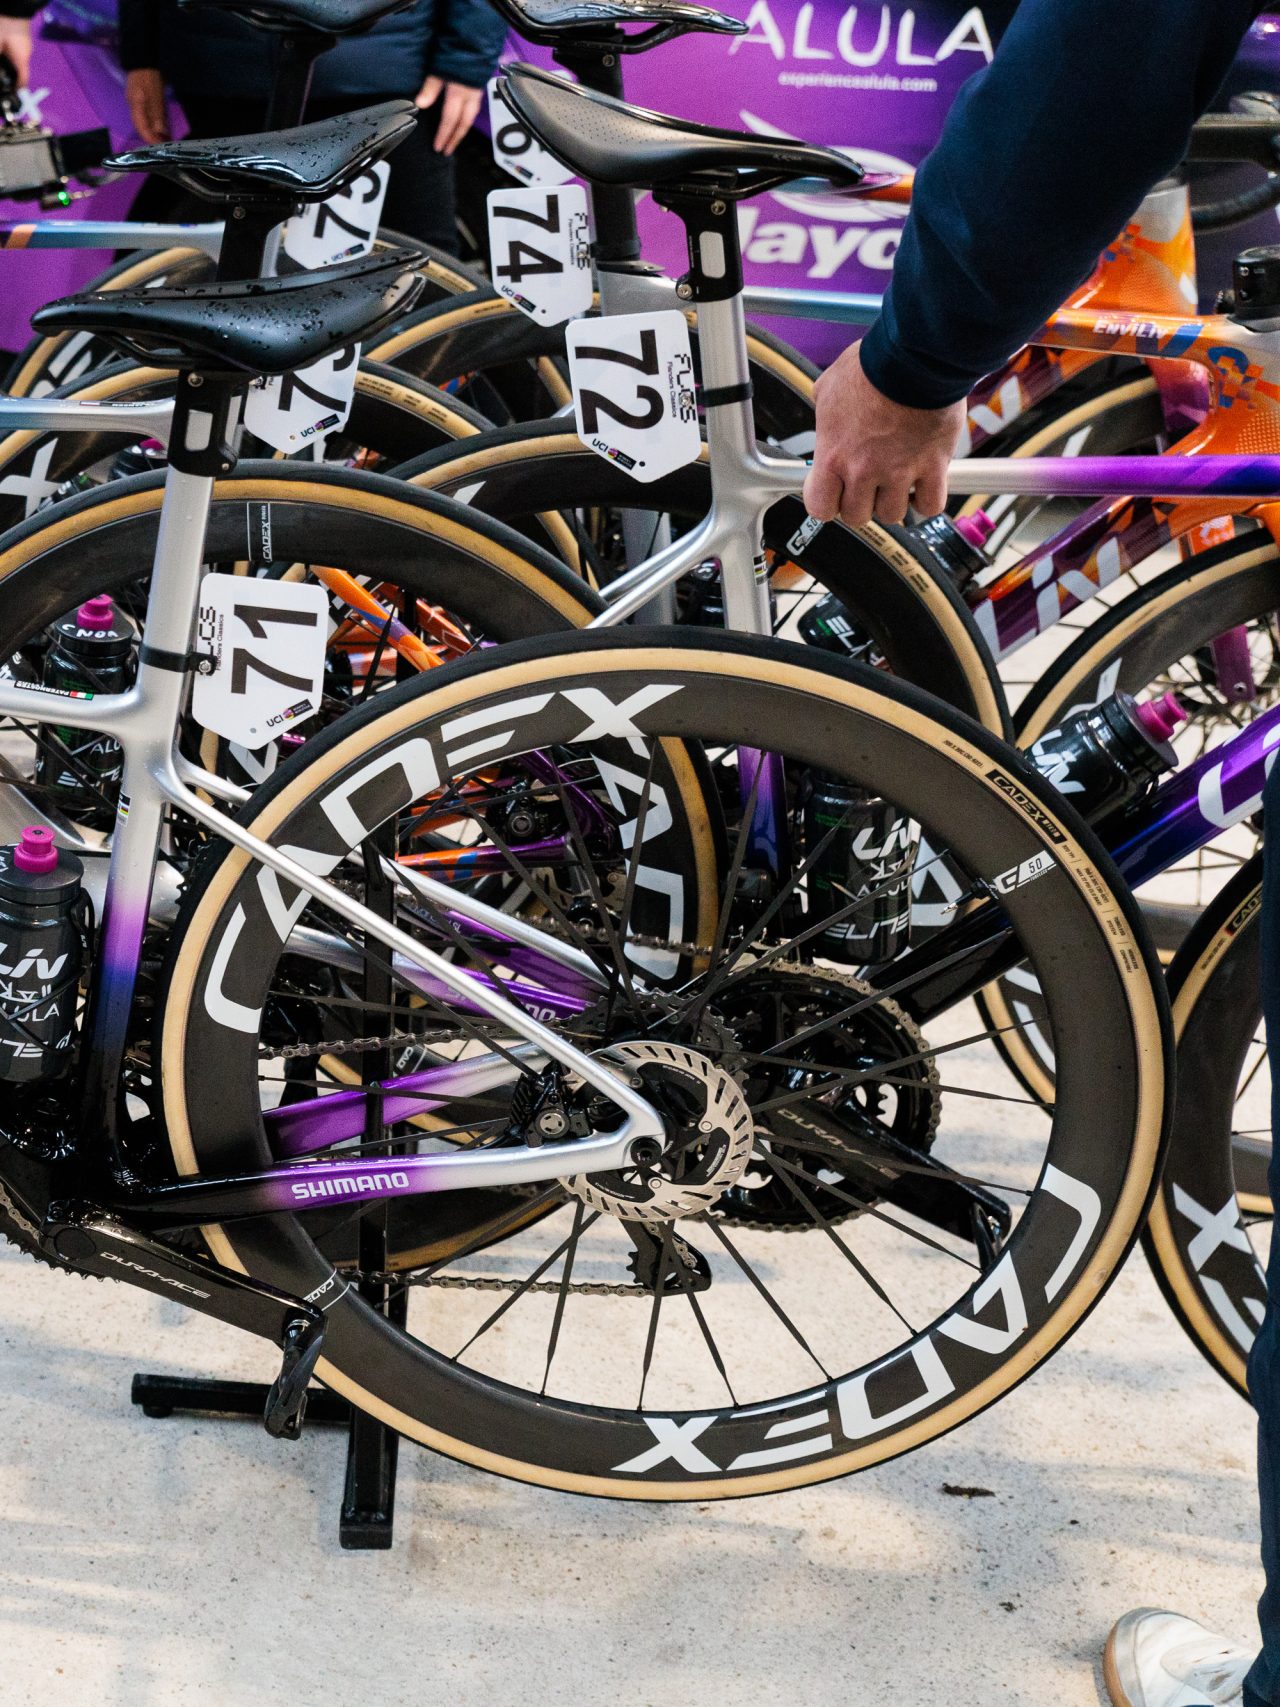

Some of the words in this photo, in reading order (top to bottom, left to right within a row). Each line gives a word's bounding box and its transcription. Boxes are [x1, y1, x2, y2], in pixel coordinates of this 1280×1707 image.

[728, 0, 994, 67] ALULA
[778, 71, 938, 92] experiencealula.com
[493, 194, 563, 283] 74
[575, 329, 665, 435] 72
[300, 426, 316, 438] UCI
[591, 437, 609, 453] UCI
[261, 520, 271, 562] CADEX
[231, 604, 318, 694] 71
[266, 713, 284, 727] UCI
[993, 775, 1046, 822] CADEX
[205, 683, 687, 1033] CADEX
[852, 817, 922, 860] Liv
[1028, 857, 1043, 874] 50
[825, 909, 910, 940] ELITE
[1233, 893, 1262, 928] CAD
[291, 1171, 410, 1200] SHIMANO
[100, 1251, 212, 1300] DURA-ACE
[305, 1279, 335, 1304] CADE
[610, 1162, 1102, 1474] CADEX
